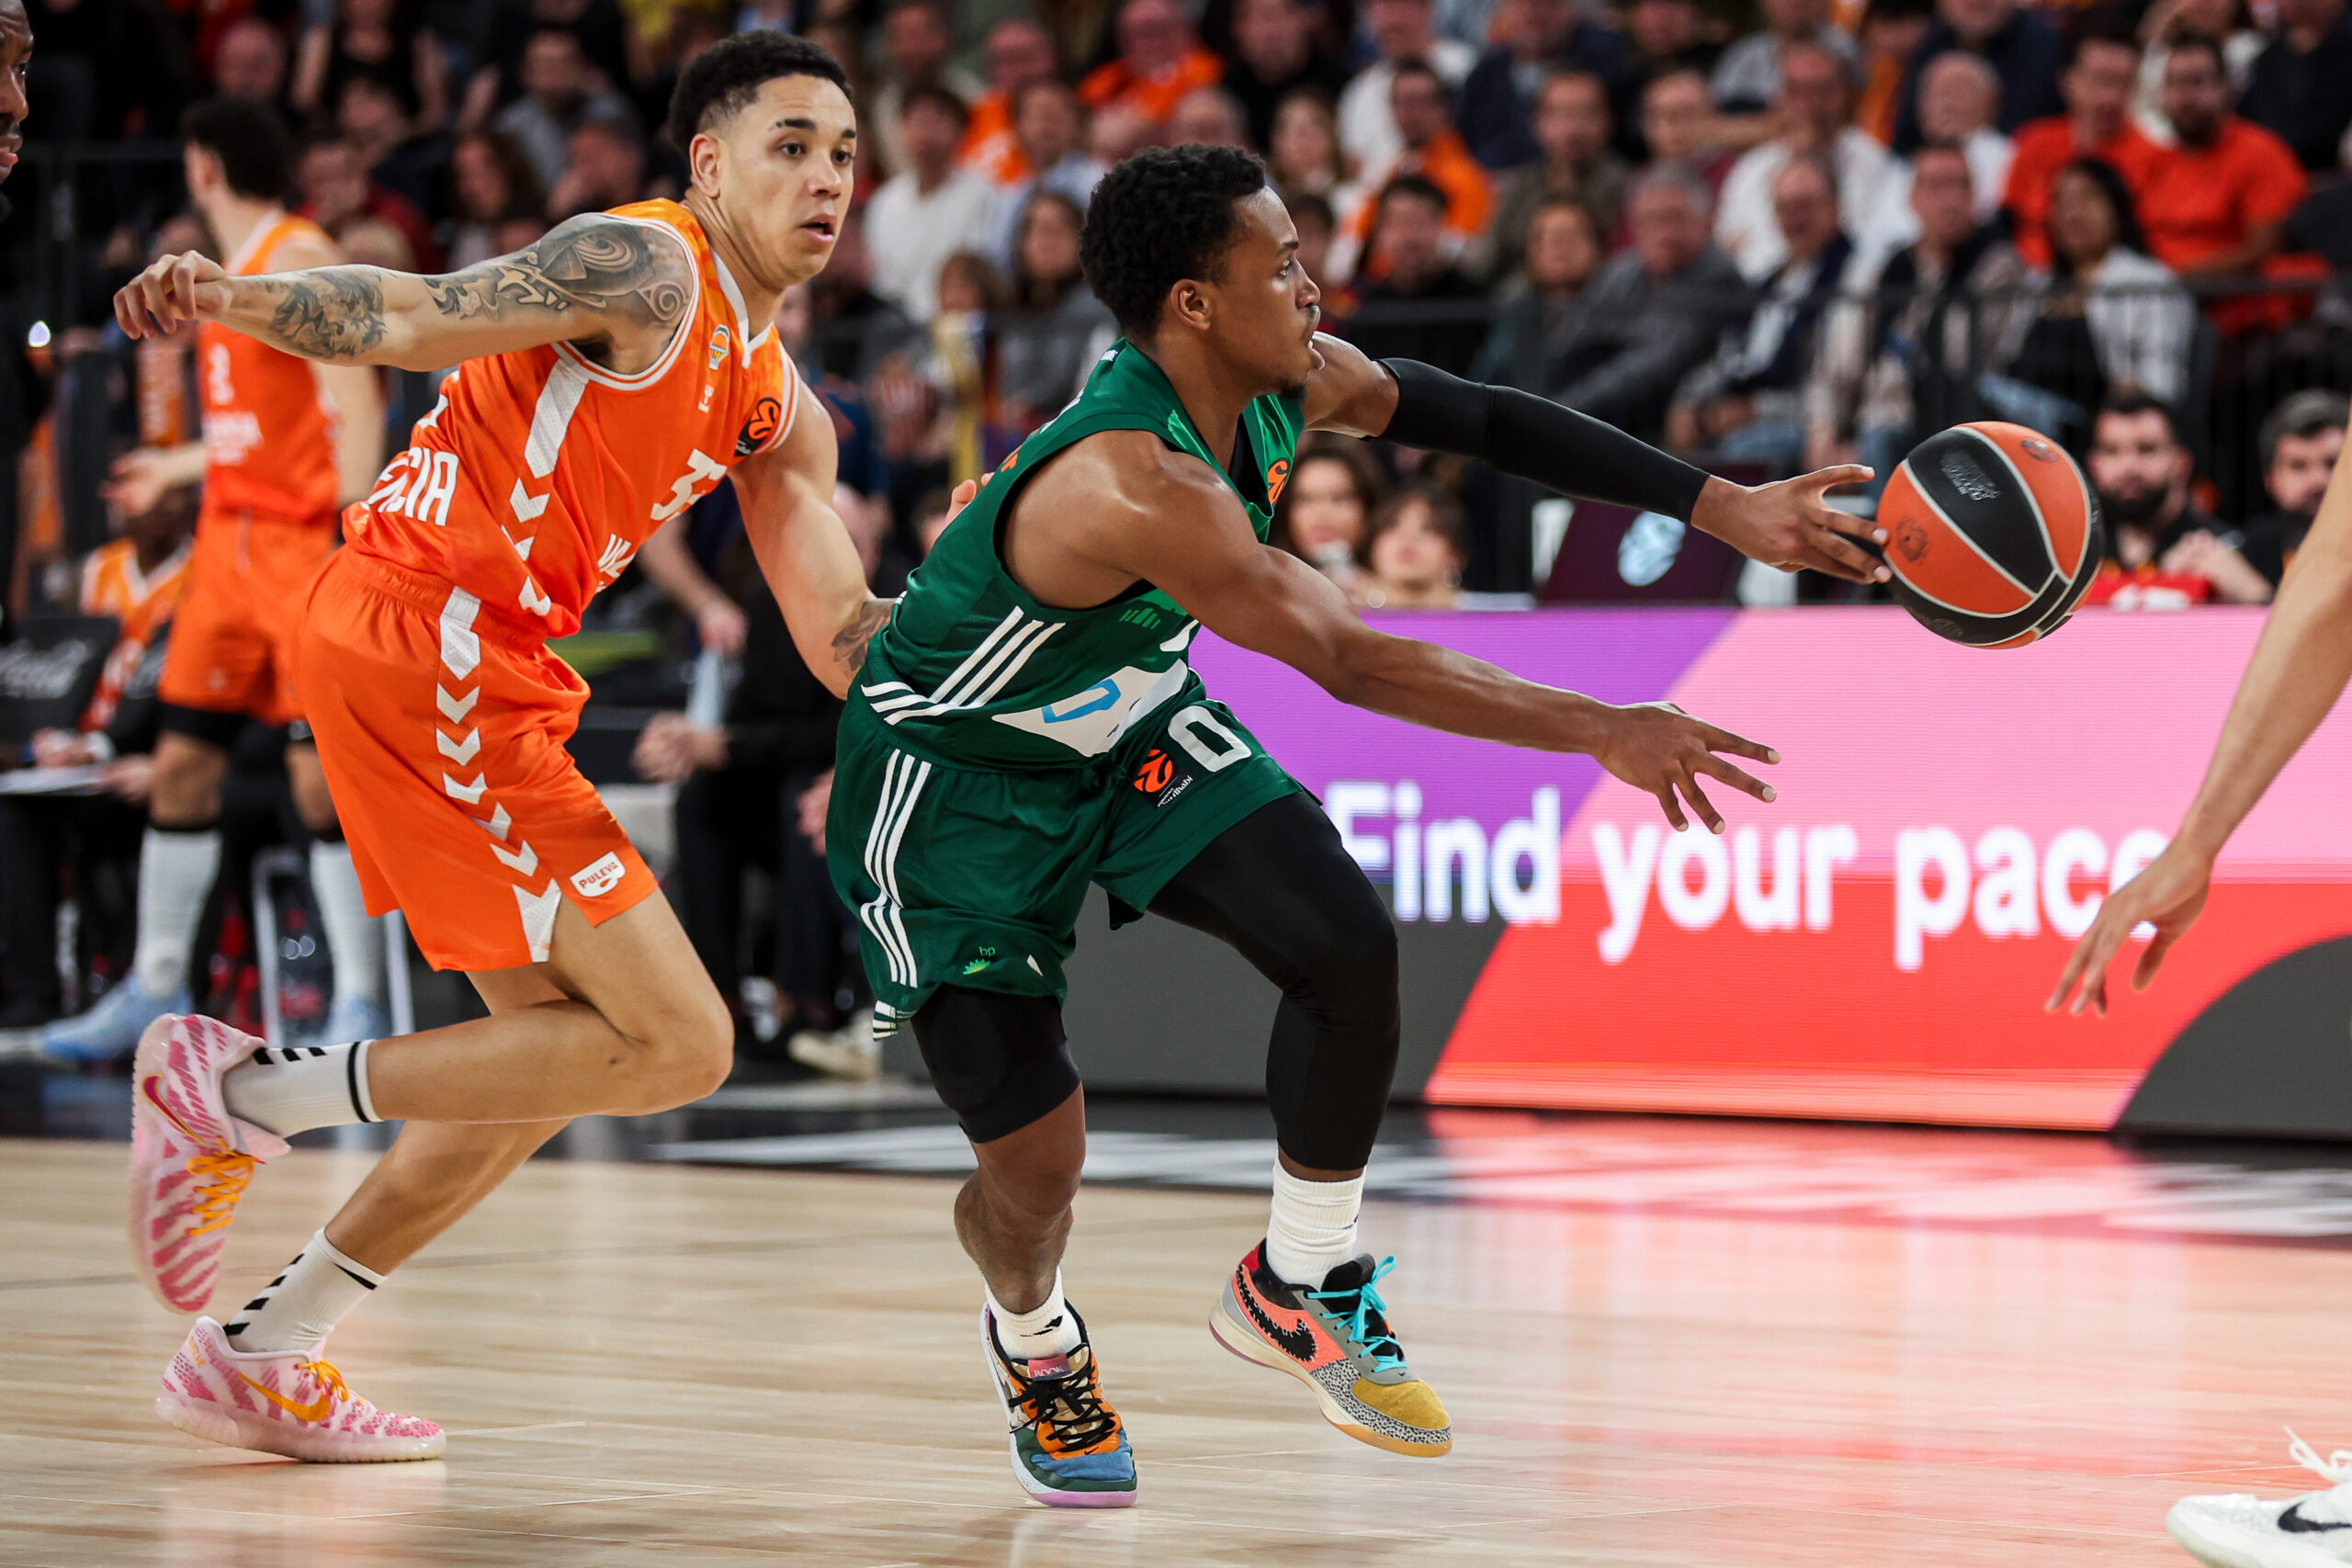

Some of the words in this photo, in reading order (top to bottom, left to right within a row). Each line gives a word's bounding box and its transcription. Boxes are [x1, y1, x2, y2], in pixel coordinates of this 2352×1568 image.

[1168, 705, 1252, 773] 0
[1323, 778, 1562, 927] Find
[1591, 822, 1859, 965] your
[978, 945, 996, 957] bp
